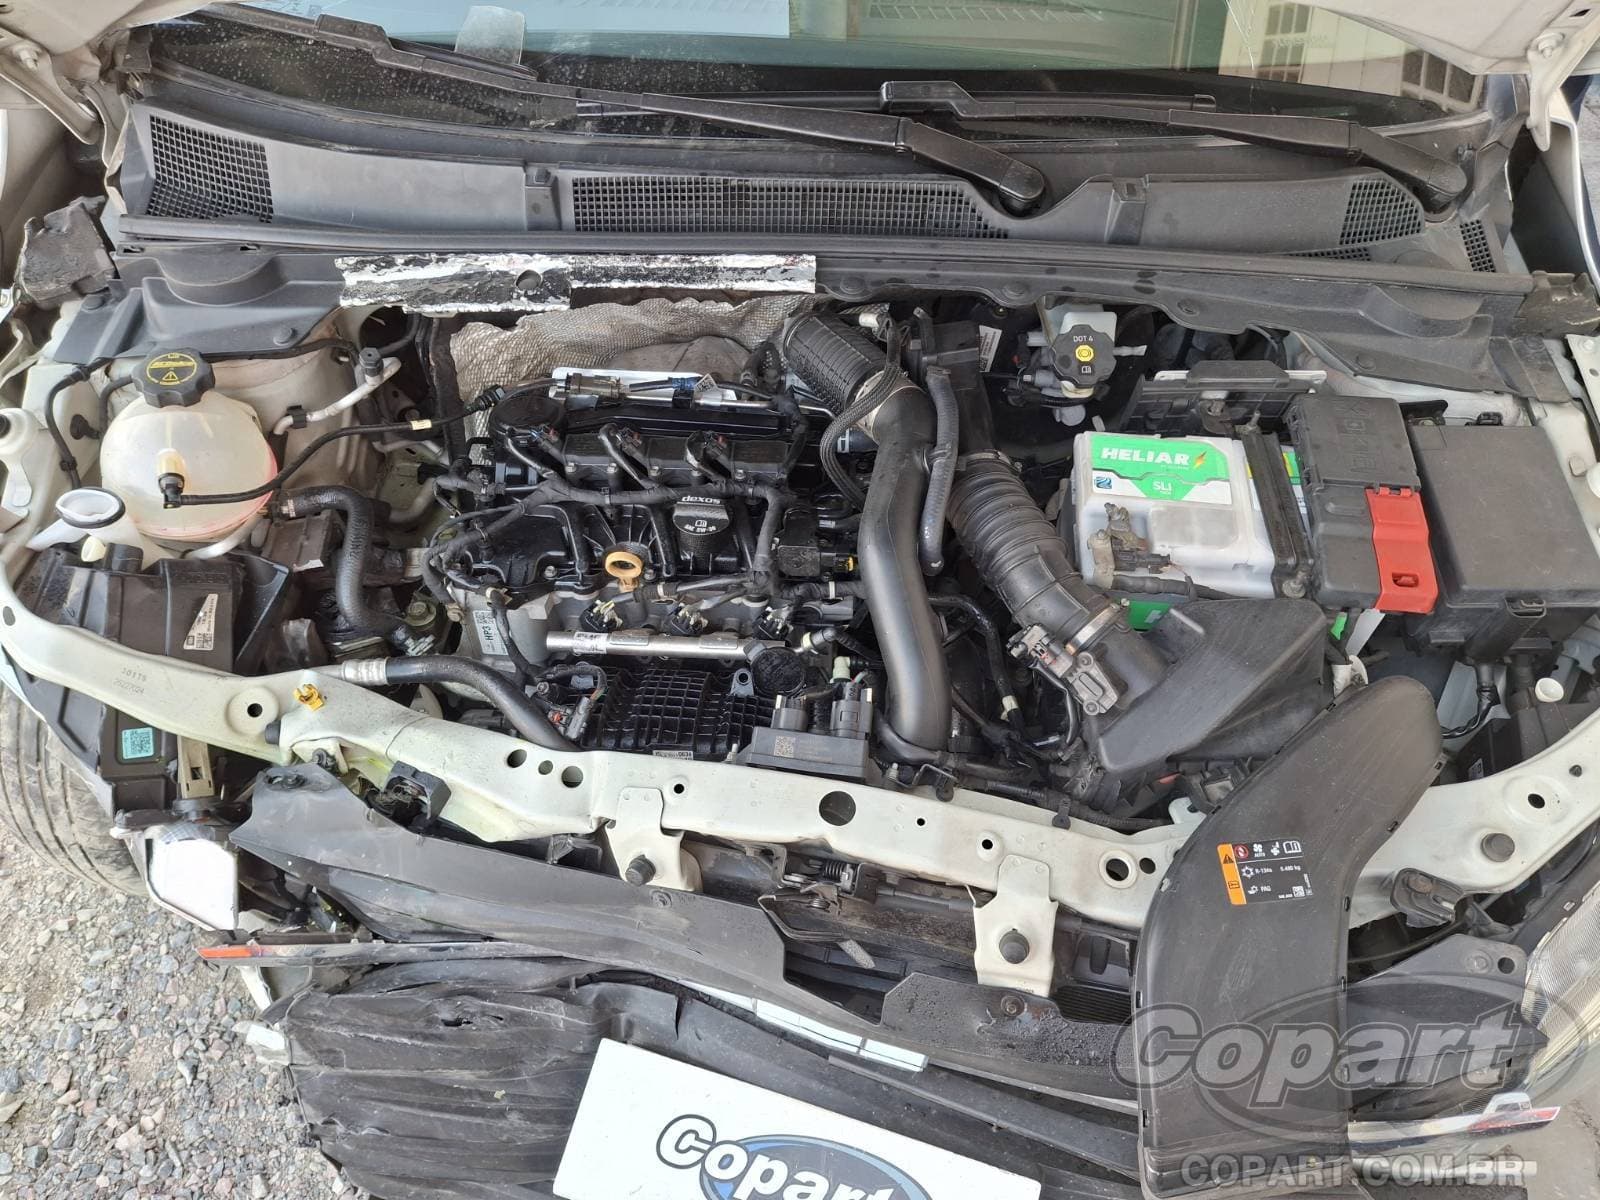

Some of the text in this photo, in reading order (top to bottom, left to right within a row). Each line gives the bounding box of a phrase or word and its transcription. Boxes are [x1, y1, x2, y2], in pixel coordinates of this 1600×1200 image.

[1100, 447, 1190, 466] HELIAR
[1152, 480, 1172, 491] SLI
[681, 495, 721, 504] dexos
[482, 624, 494, 640] HP3
[656, 1114, 895, 1200] Copa
